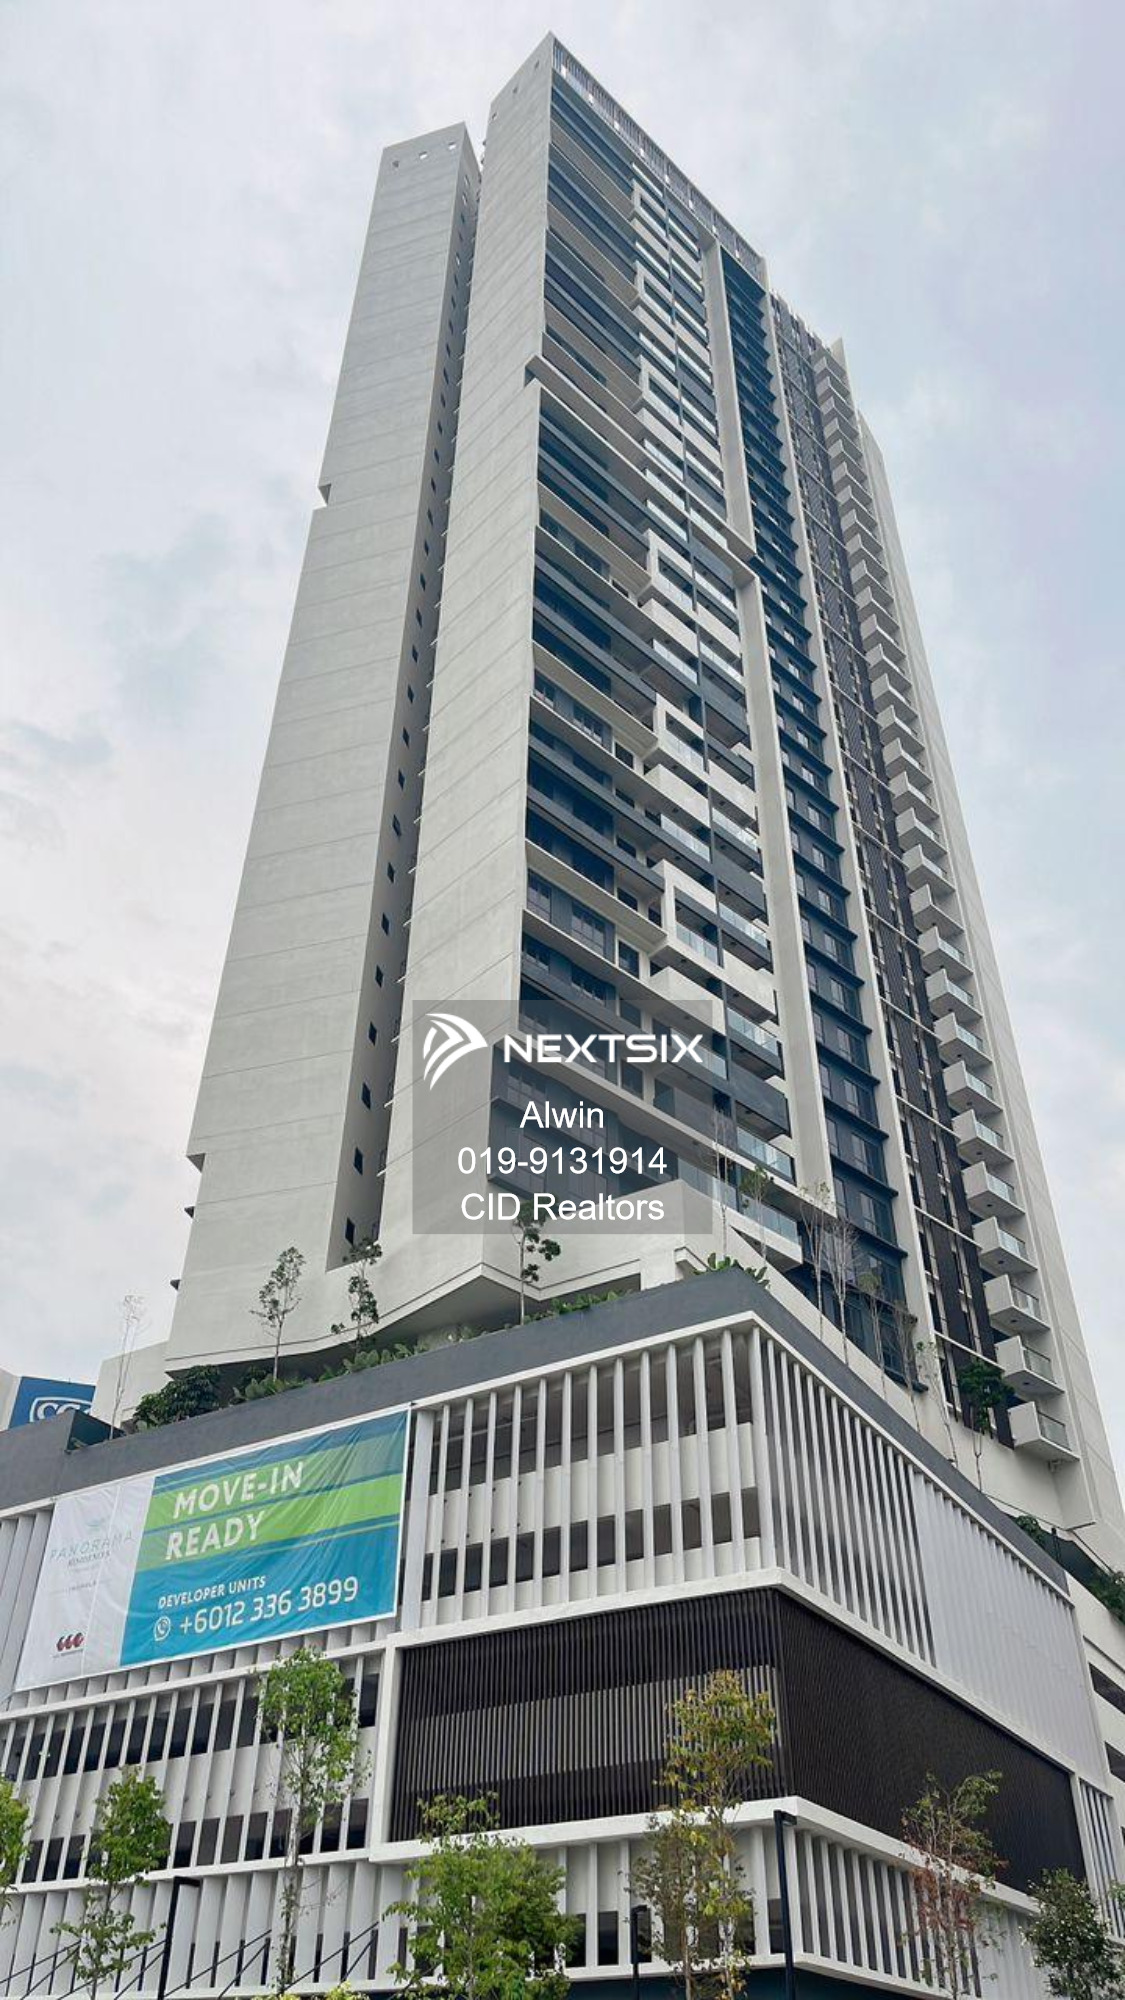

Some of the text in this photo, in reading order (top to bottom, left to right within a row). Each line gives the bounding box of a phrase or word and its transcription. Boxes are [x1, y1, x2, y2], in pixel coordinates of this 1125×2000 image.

[172, 1461, 305, 1519] MOVE-IN
[165, 1510, 265, 1560] READY
[158, 1575, 266, 1609] DEVELOPER UNITS
[180, 1576, 359, 1634] +6012 336 3899
